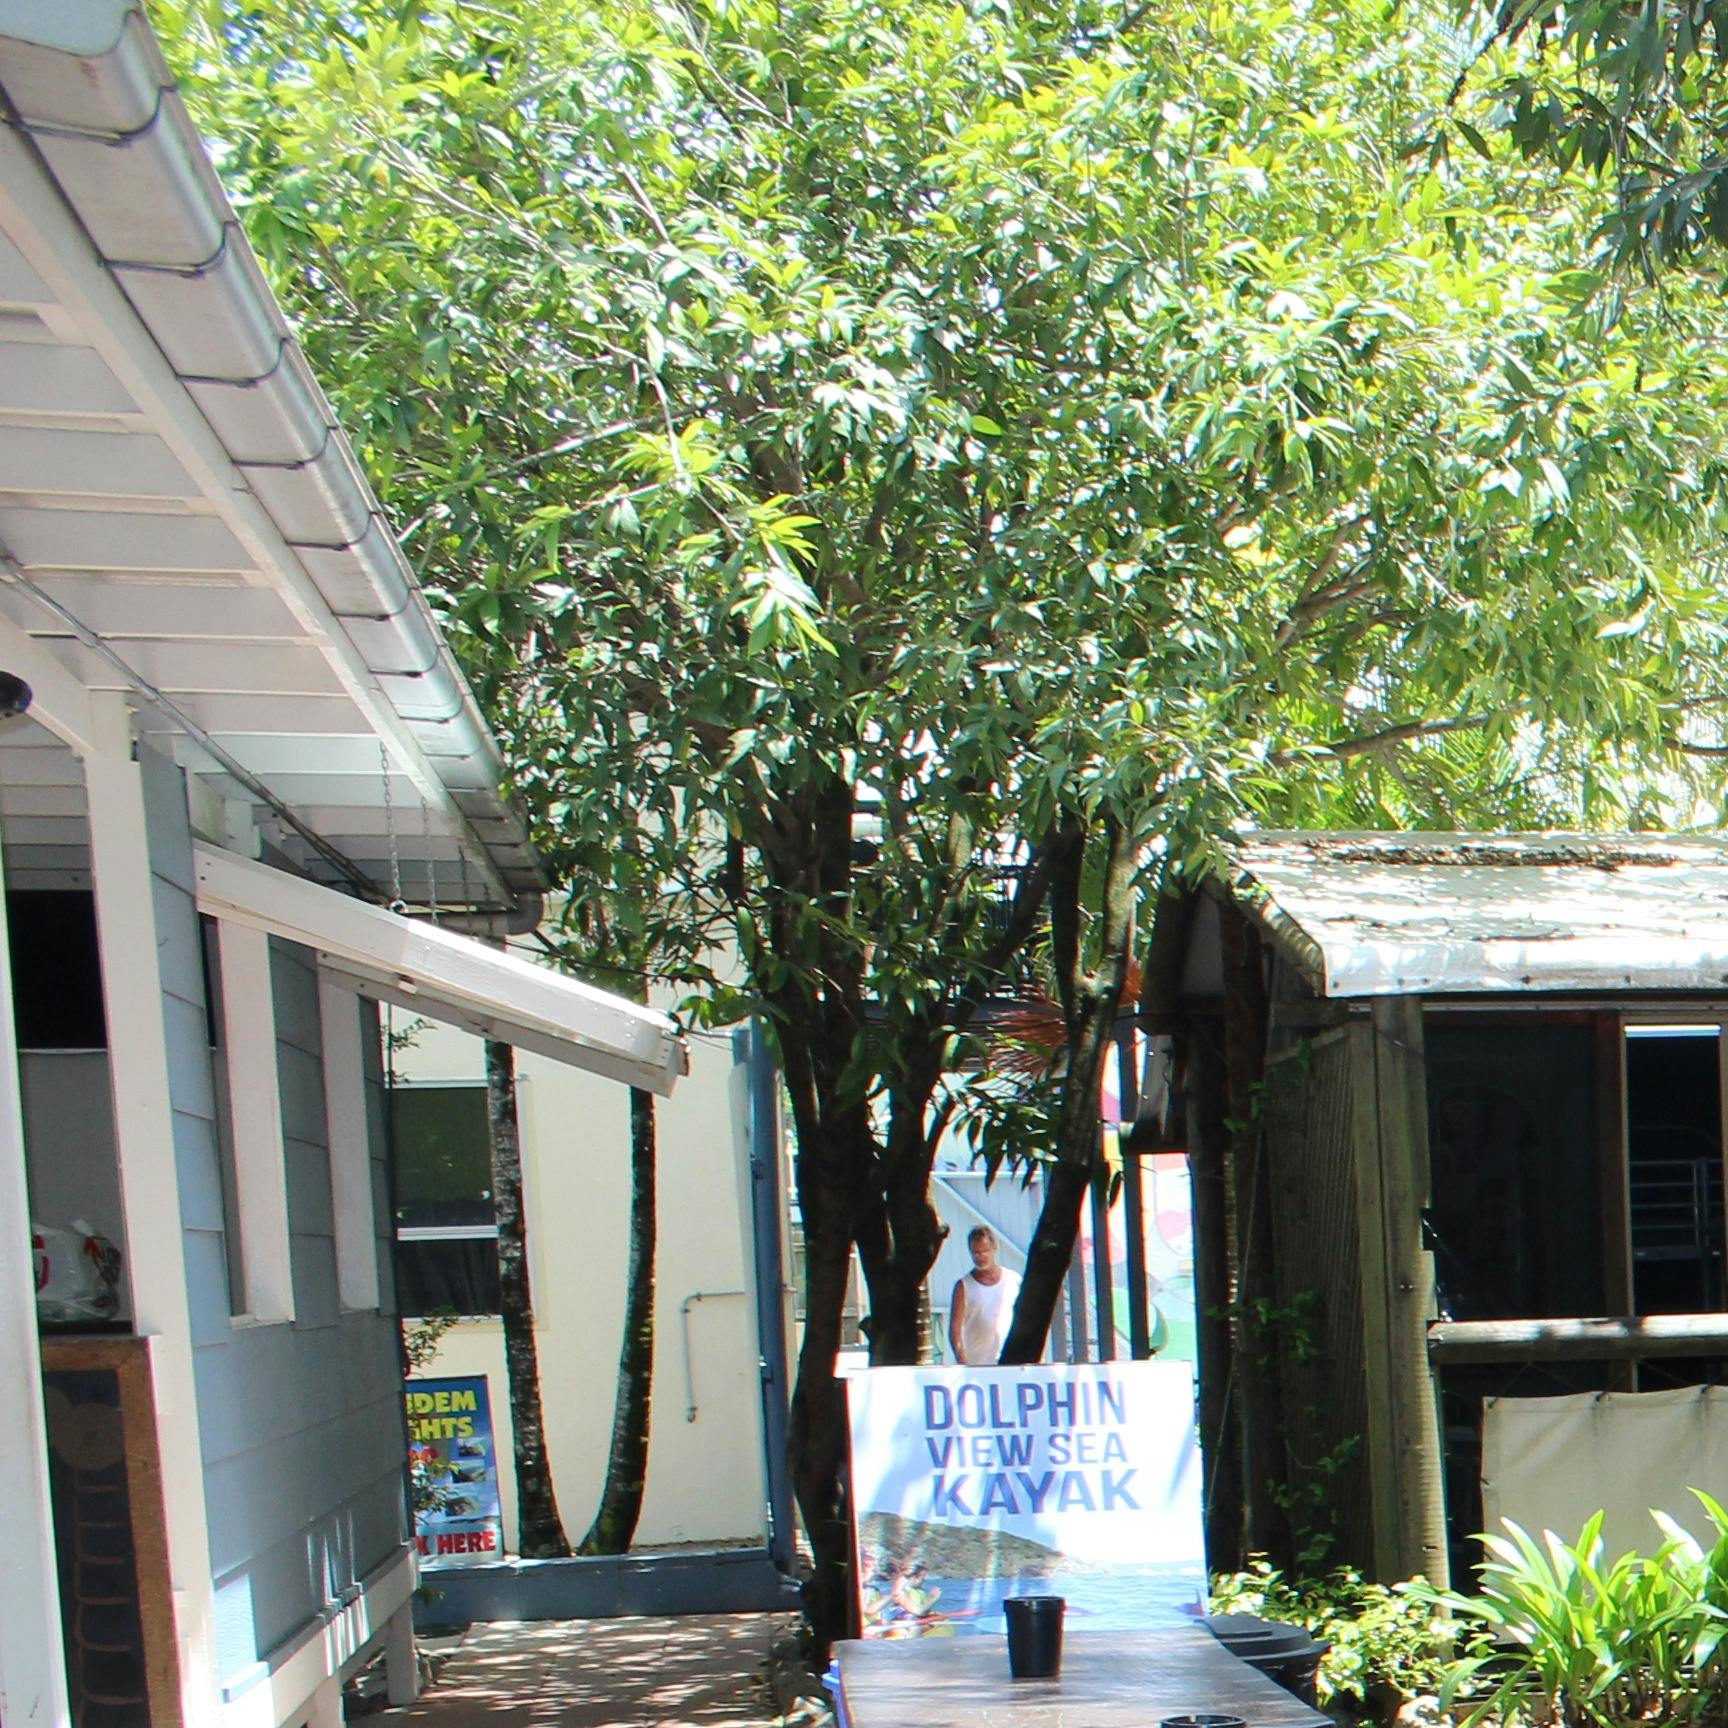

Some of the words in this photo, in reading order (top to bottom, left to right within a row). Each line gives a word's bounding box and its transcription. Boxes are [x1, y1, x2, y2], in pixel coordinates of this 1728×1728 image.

[923, 1381, 1126, 1430] DOLPHIN
[924, 1434, 1034, 1468] VIEW
[1048, 1432, 1128, 1465] SEA
[932, 1469, 1142, 1517] KAYAK
[436, 1531, 497, 1555] HERE
